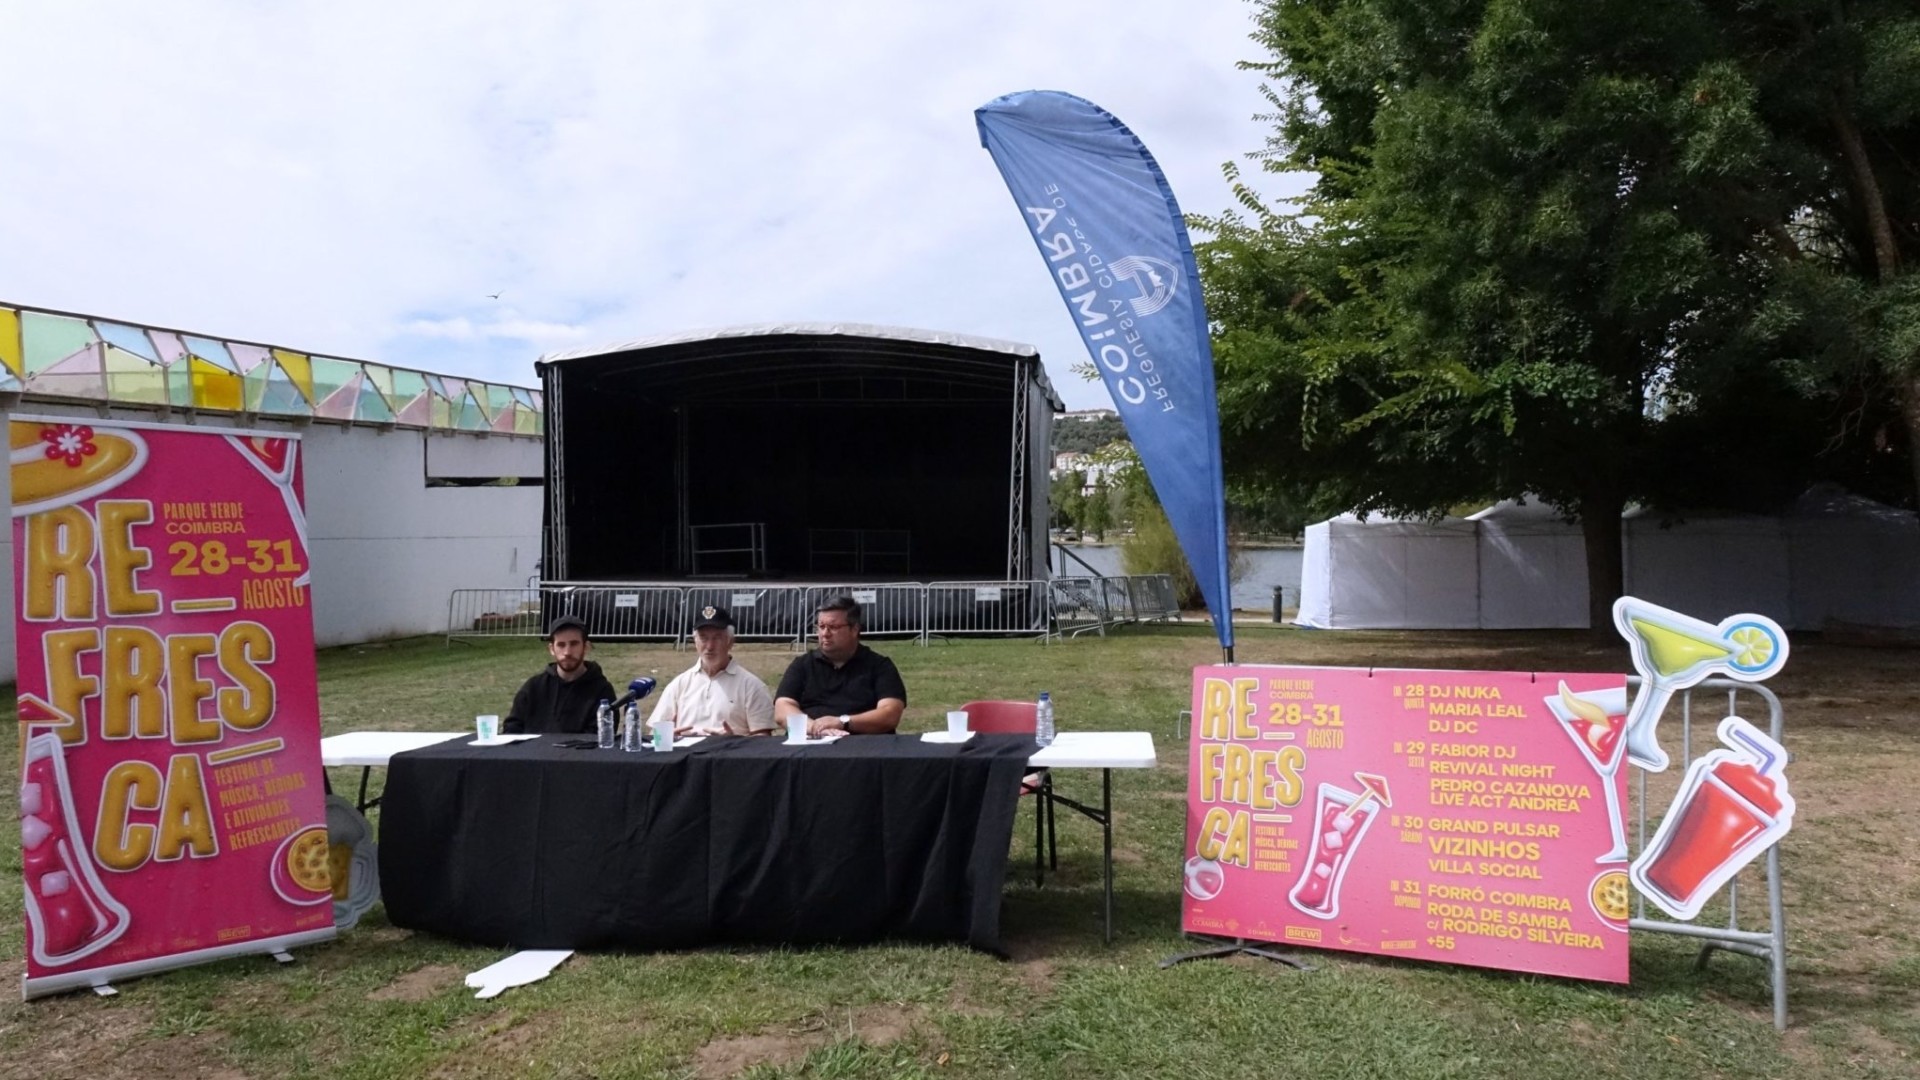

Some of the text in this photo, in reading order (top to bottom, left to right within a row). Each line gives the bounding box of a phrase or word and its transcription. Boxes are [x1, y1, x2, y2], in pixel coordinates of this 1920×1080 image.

[163, 502, 244, 520] PARQUE VERDE
[165, 522, 246, 534] COIMBRA
[23, 500, 163, 622] RE
[168, 539, 301, 576] 28-31
[242, 578, 304, 610] AGOSTO
[42, 620, 276, 747] FRES
[1405, 684, 1425, 697] 28
[1429, 685, 1501, 699] DJ NUKA
[1269, 691, 1314, 700] COIMBRA
[1199, 677, 1260, 741] RE
[1269, 702, 1344, 727] 28-31
[1429, 702, 1527, 718] MARIA LEAL
[1429, 720, 1479, 734] DJ DC
[1307, 728, 1344, 749] AGOSTO
[1406, 741, 1426, 754] 29
[1430, 743, 1516, 759] FABIOR DJ
[214, 760, 260, 787] FESTIVAL
[1200, 743, 1306, 811] FRES
[1430, 761, 1555, 779] REVIVAL NIGHT
[1430, 778, 1591, 799] PEDRO CAZANOVA
[93, 754, 219, 872] CA
[224, 798, 291, 829] E ATIVIDADES
[1430, 793, 1581, 813] LIVE ACT ANDREA
[1403, 815, 1424, 830] 30
[1428, 818, 1561, 839] GRAND PULSAR
[1196, 807, 1250, 868] CA
[1428, 836, 1541, 860] VIZINHOS
[1428, 858, 1543, 880] VILLA SOCIAL
[1403, 880, 1422, 895] 31
[1427, 884, 1573, 912] FORRÓ COIMBRA
[1427, 902, 1572, 931] RODA DE SAMBA
[1287, 927, 1320, 940] BREW!
[1426, 919, 1605, 950] c/ RODRIGO SILVEIRA
[1426, 936, 1456, 950] +55
